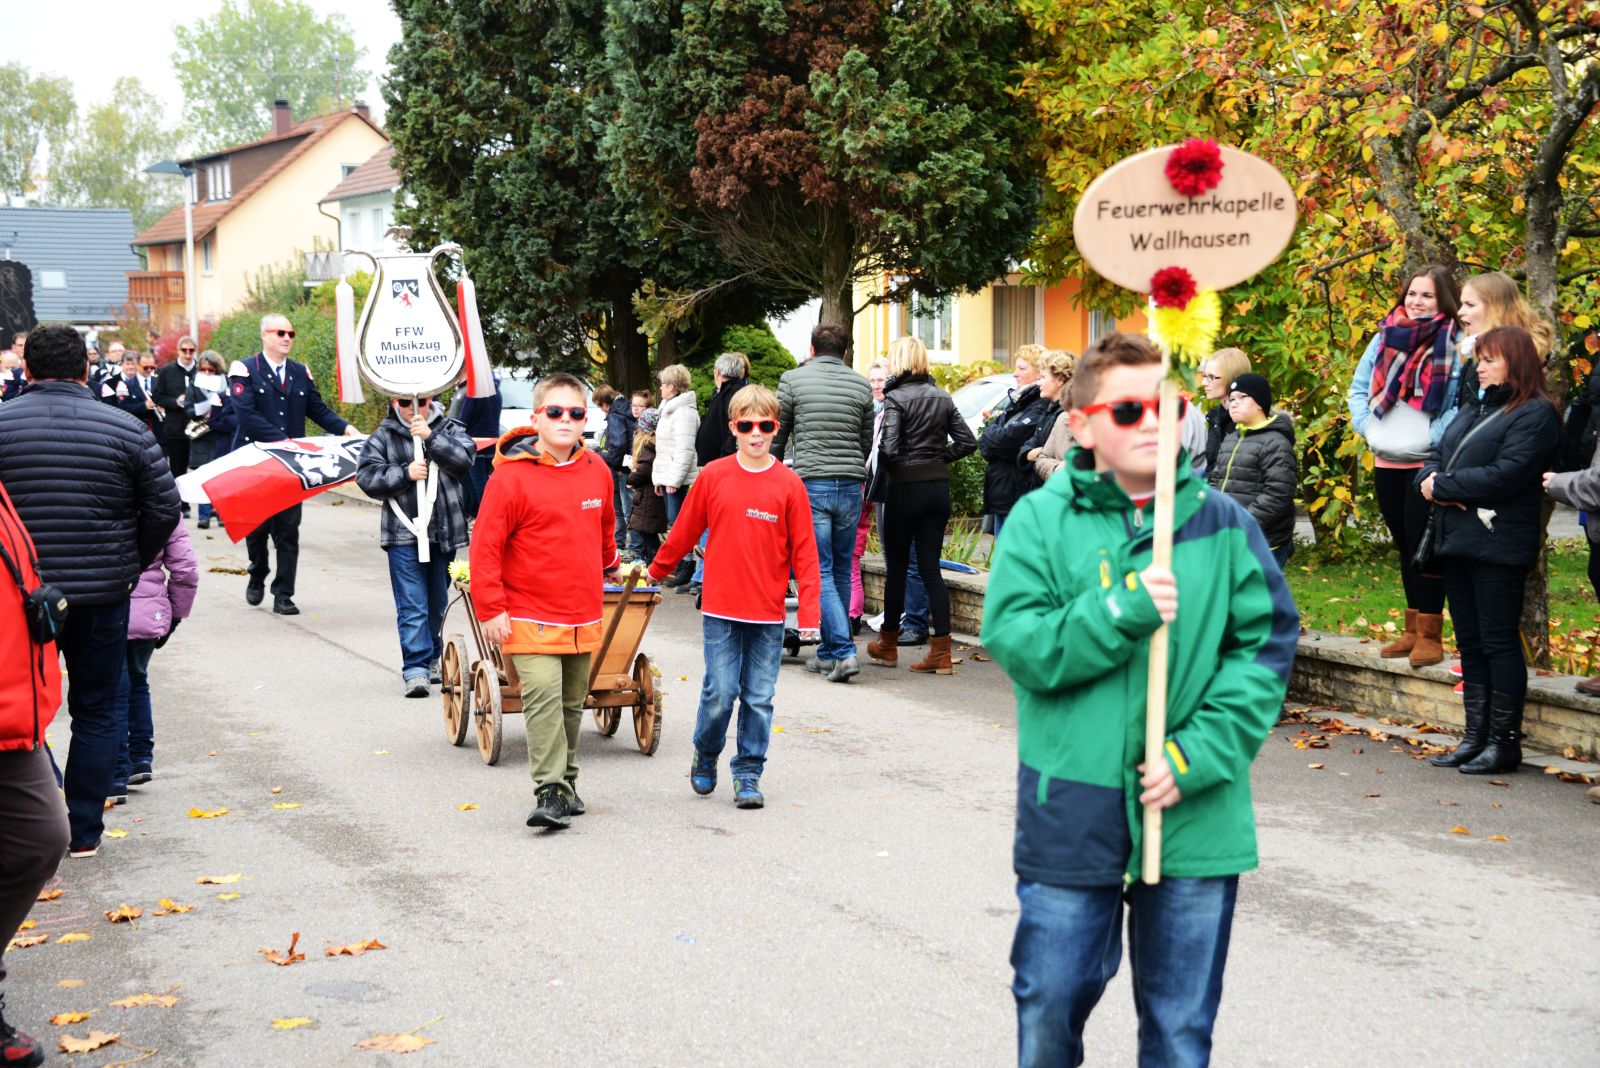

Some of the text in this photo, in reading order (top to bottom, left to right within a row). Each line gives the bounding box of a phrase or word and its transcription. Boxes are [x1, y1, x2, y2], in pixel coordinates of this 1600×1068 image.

[1097, 192, 1285, 220] Feuerwehrkapelle
[1130, 230, 1250, 251] Wallhausen
[395, 326, 424, 336] FFW
[381, 341, 441, 351] Musikzug
[375, 354, 448, 365] Wallhausen
